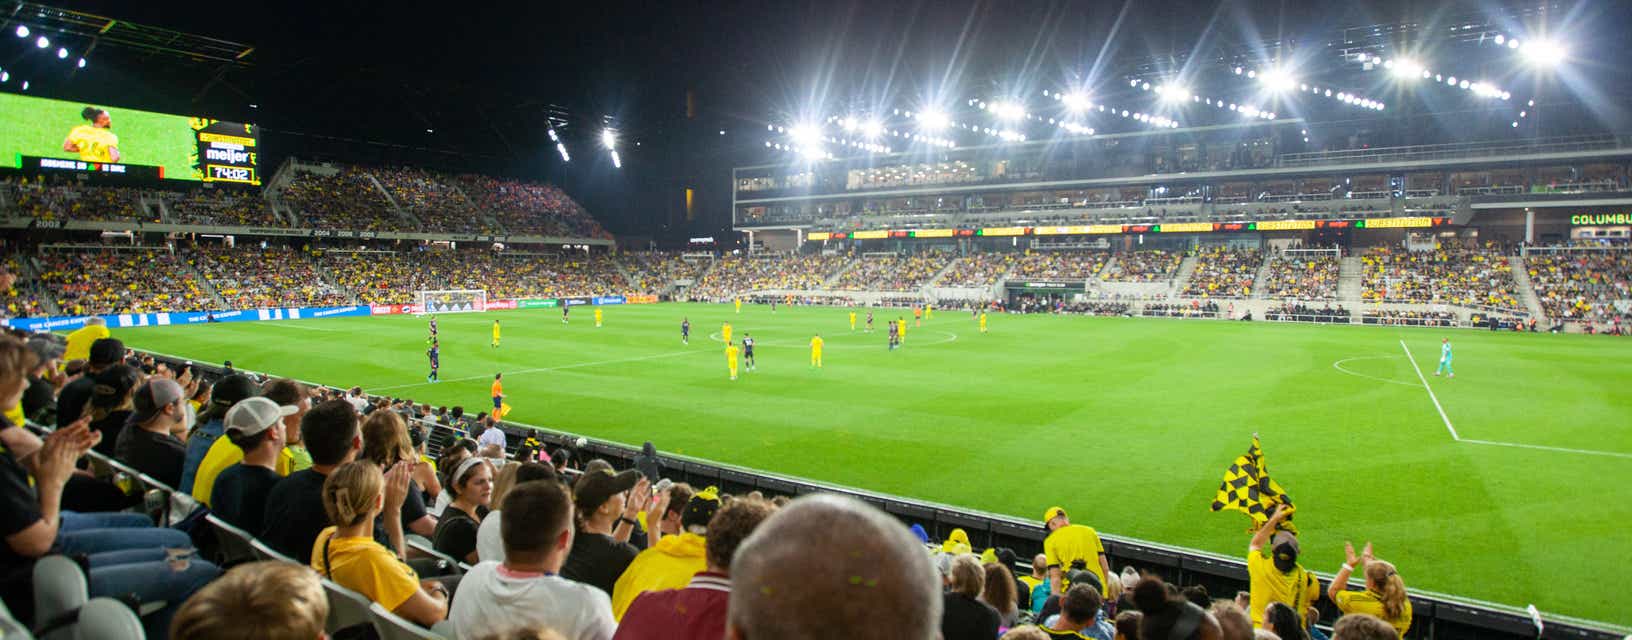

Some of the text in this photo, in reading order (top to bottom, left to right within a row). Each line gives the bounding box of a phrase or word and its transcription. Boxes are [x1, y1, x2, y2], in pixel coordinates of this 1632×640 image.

[207, 149, 248, 164] meijer
[215, 167, 249, 180] 74:02
[36, 220, 60, 228] 2002
[1571, 214, 1632, 225] COLUMBU
